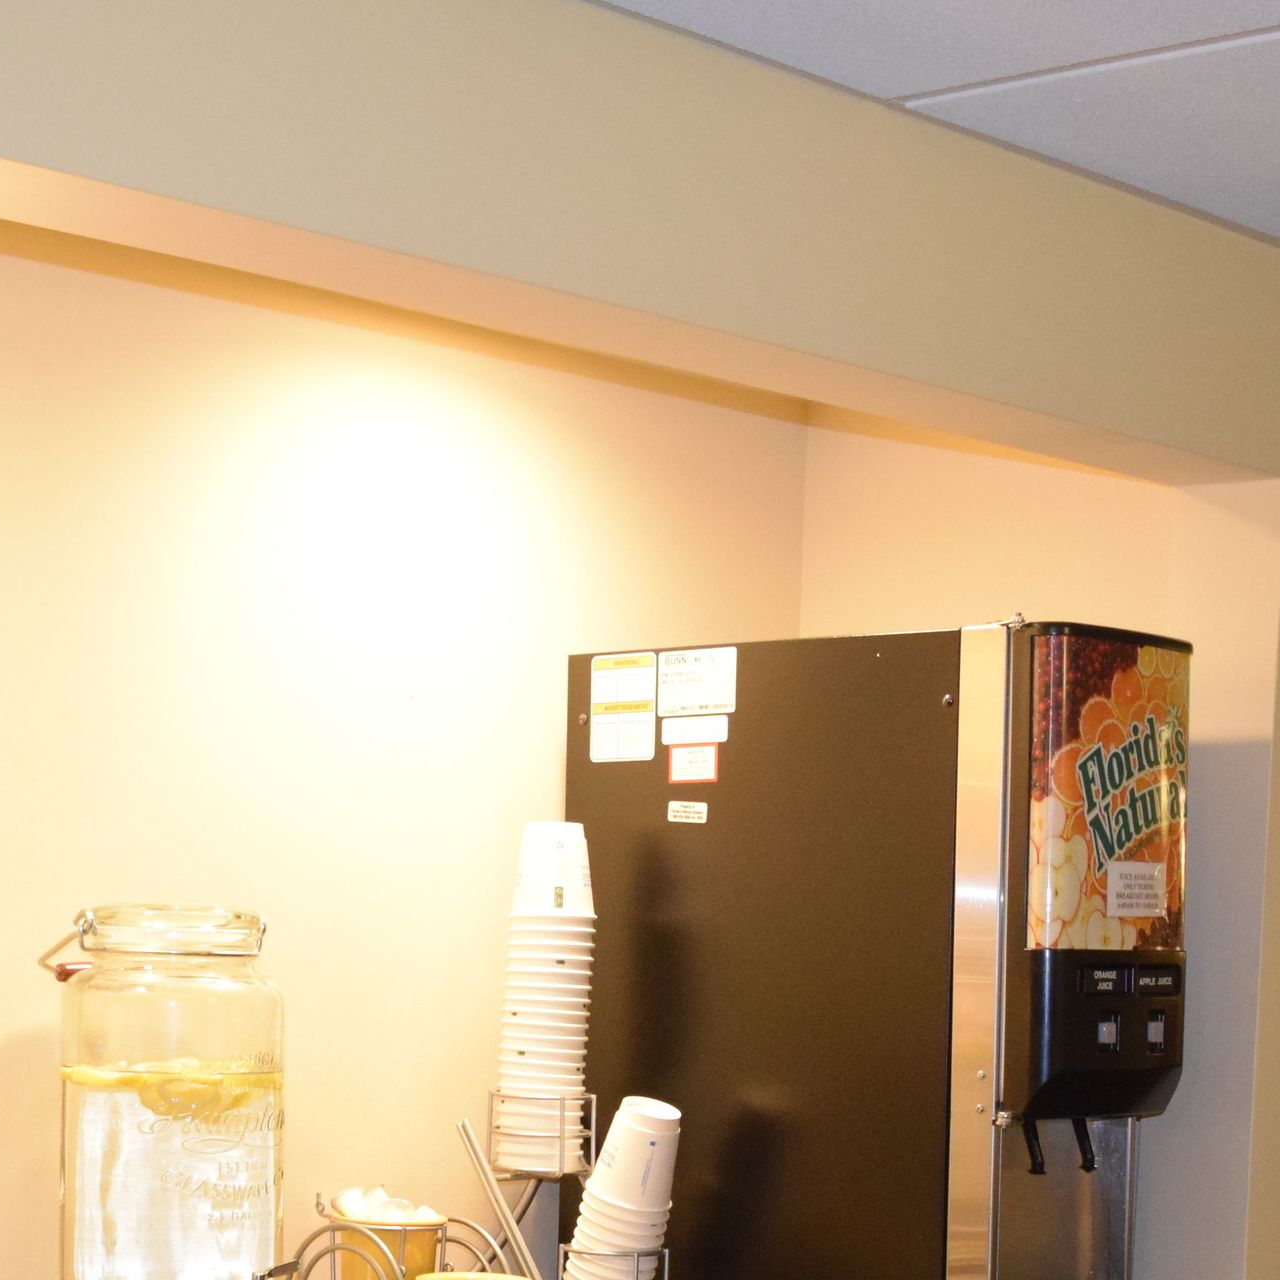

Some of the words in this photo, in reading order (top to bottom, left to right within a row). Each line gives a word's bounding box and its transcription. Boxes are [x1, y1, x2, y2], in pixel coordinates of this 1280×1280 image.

[1089, 770, 1188, 874] Natural
[1093, 970, 1117, 979] ORANGE
[1139, 977, 1156, 985] APPLE
[1157, 976, 1172, 985] JUICE
[1097, 981, 1113, 990] JUICE
